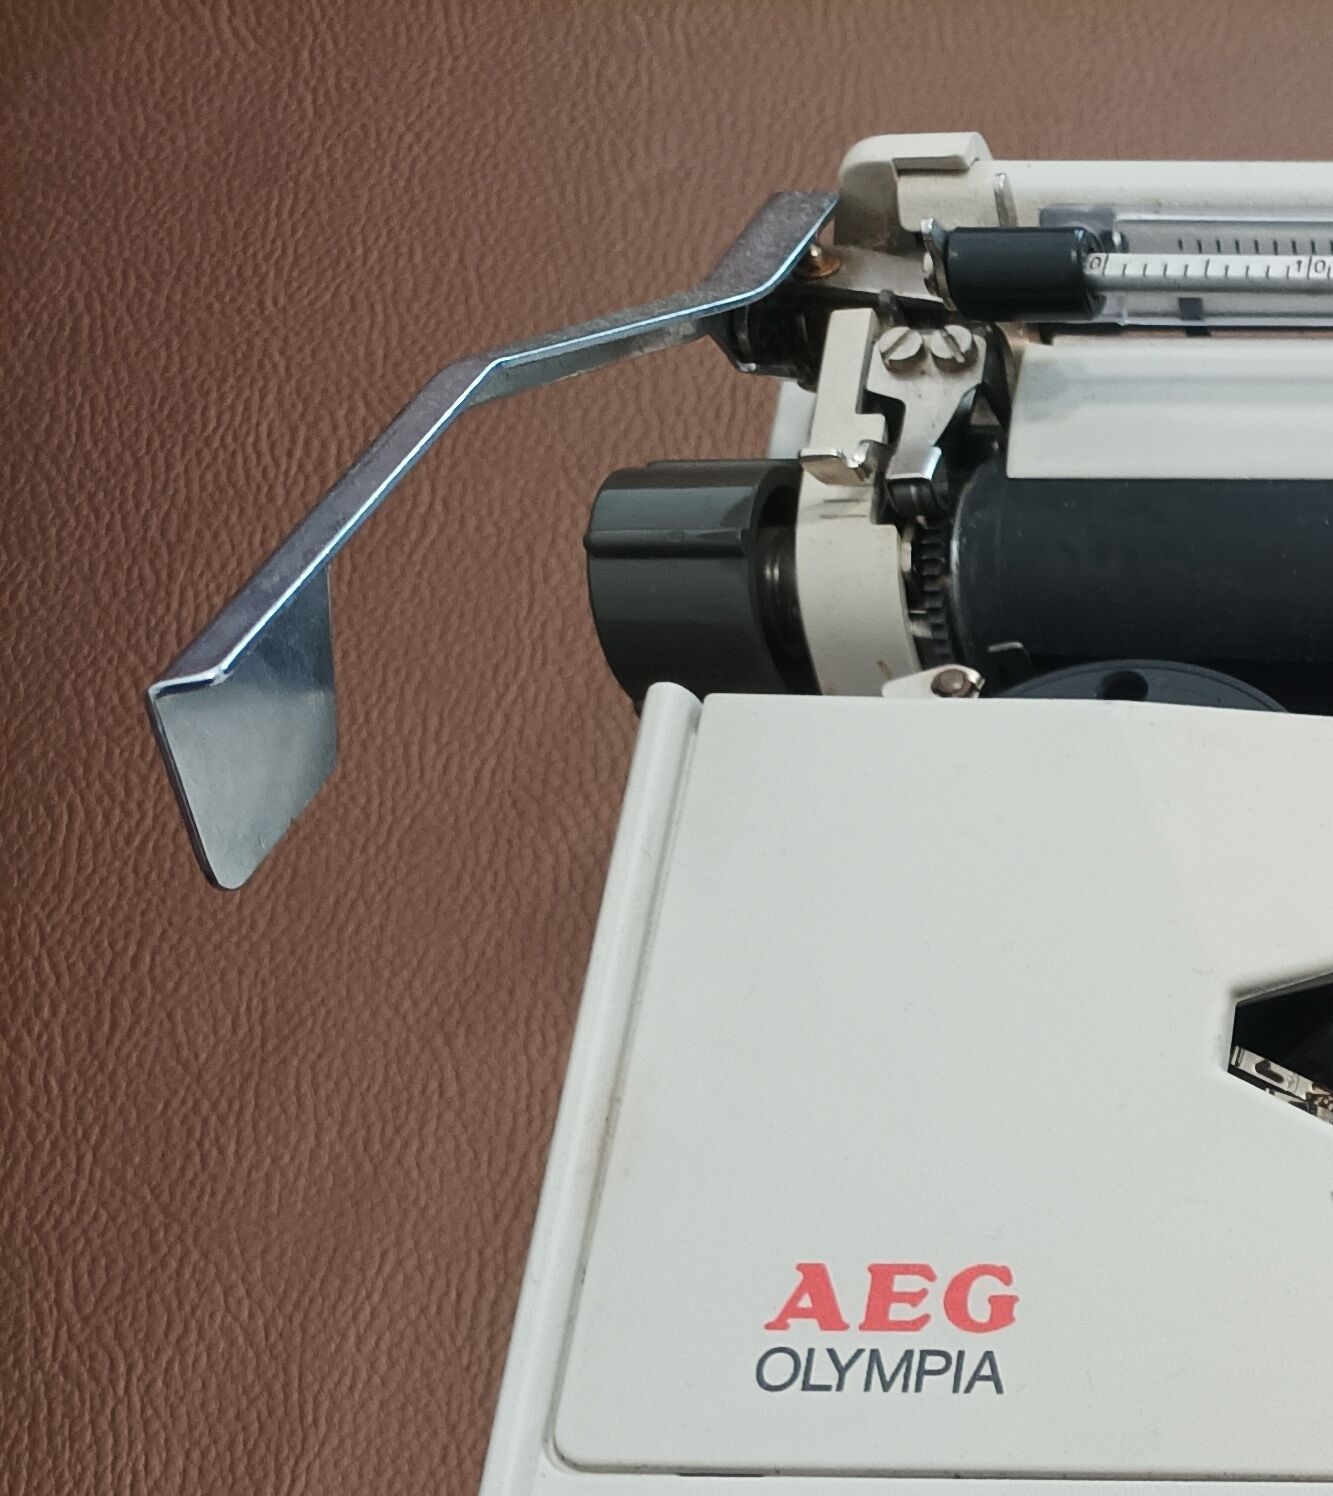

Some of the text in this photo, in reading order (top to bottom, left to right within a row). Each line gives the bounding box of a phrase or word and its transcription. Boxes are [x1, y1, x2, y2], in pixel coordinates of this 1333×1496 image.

[1295, 259, 1328, 275] 10
[764, 1262, 1020, 1334] AEG
[755, 1346, 1005, 1395] OLYMPIA
